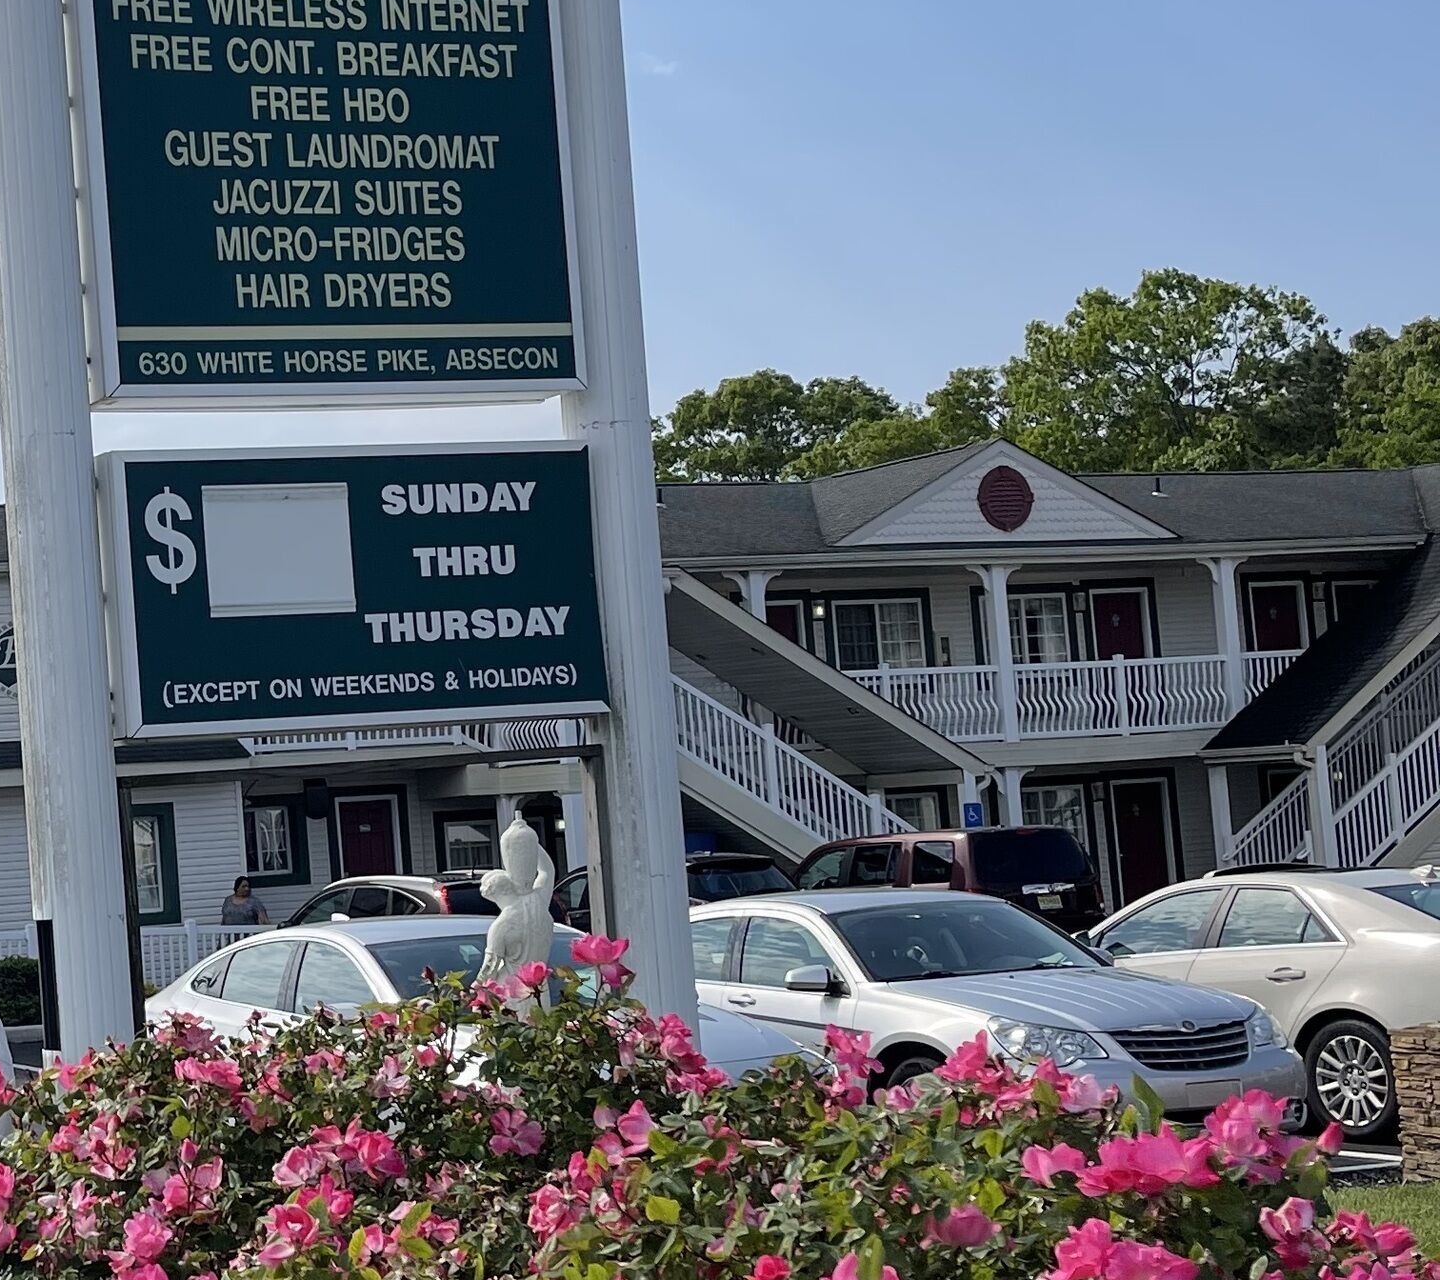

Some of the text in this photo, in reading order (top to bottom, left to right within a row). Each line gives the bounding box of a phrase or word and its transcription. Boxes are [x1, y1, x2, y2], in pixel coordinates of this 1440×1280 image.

[131, 34, 517, 78] FREE CONT. BREAKFAST
[251, 86, 408, 122] FREE HBO
[166, 131, 498, 169] GUEST LAUNDROMAT
[214, 179, 461, 215] JACUZZI SUITES
[217, 226, 464, 261] MICRO-FRIDGES
[236, 273, 451, 307] HAIR DRYERS
[140, 348, 557, 375] 630 WHITE HORSE PIKE, ABSECON
[382, 482, 536, 514] SUNDAY
[145, 487, 196, 594] $
[413, 545, 515, 576] THRU
[365, 606, 569, 643] THURSDAY
[164, 664, 576, 707] (EXCEPT ON WEEKENDS & HOLIDAYS)
